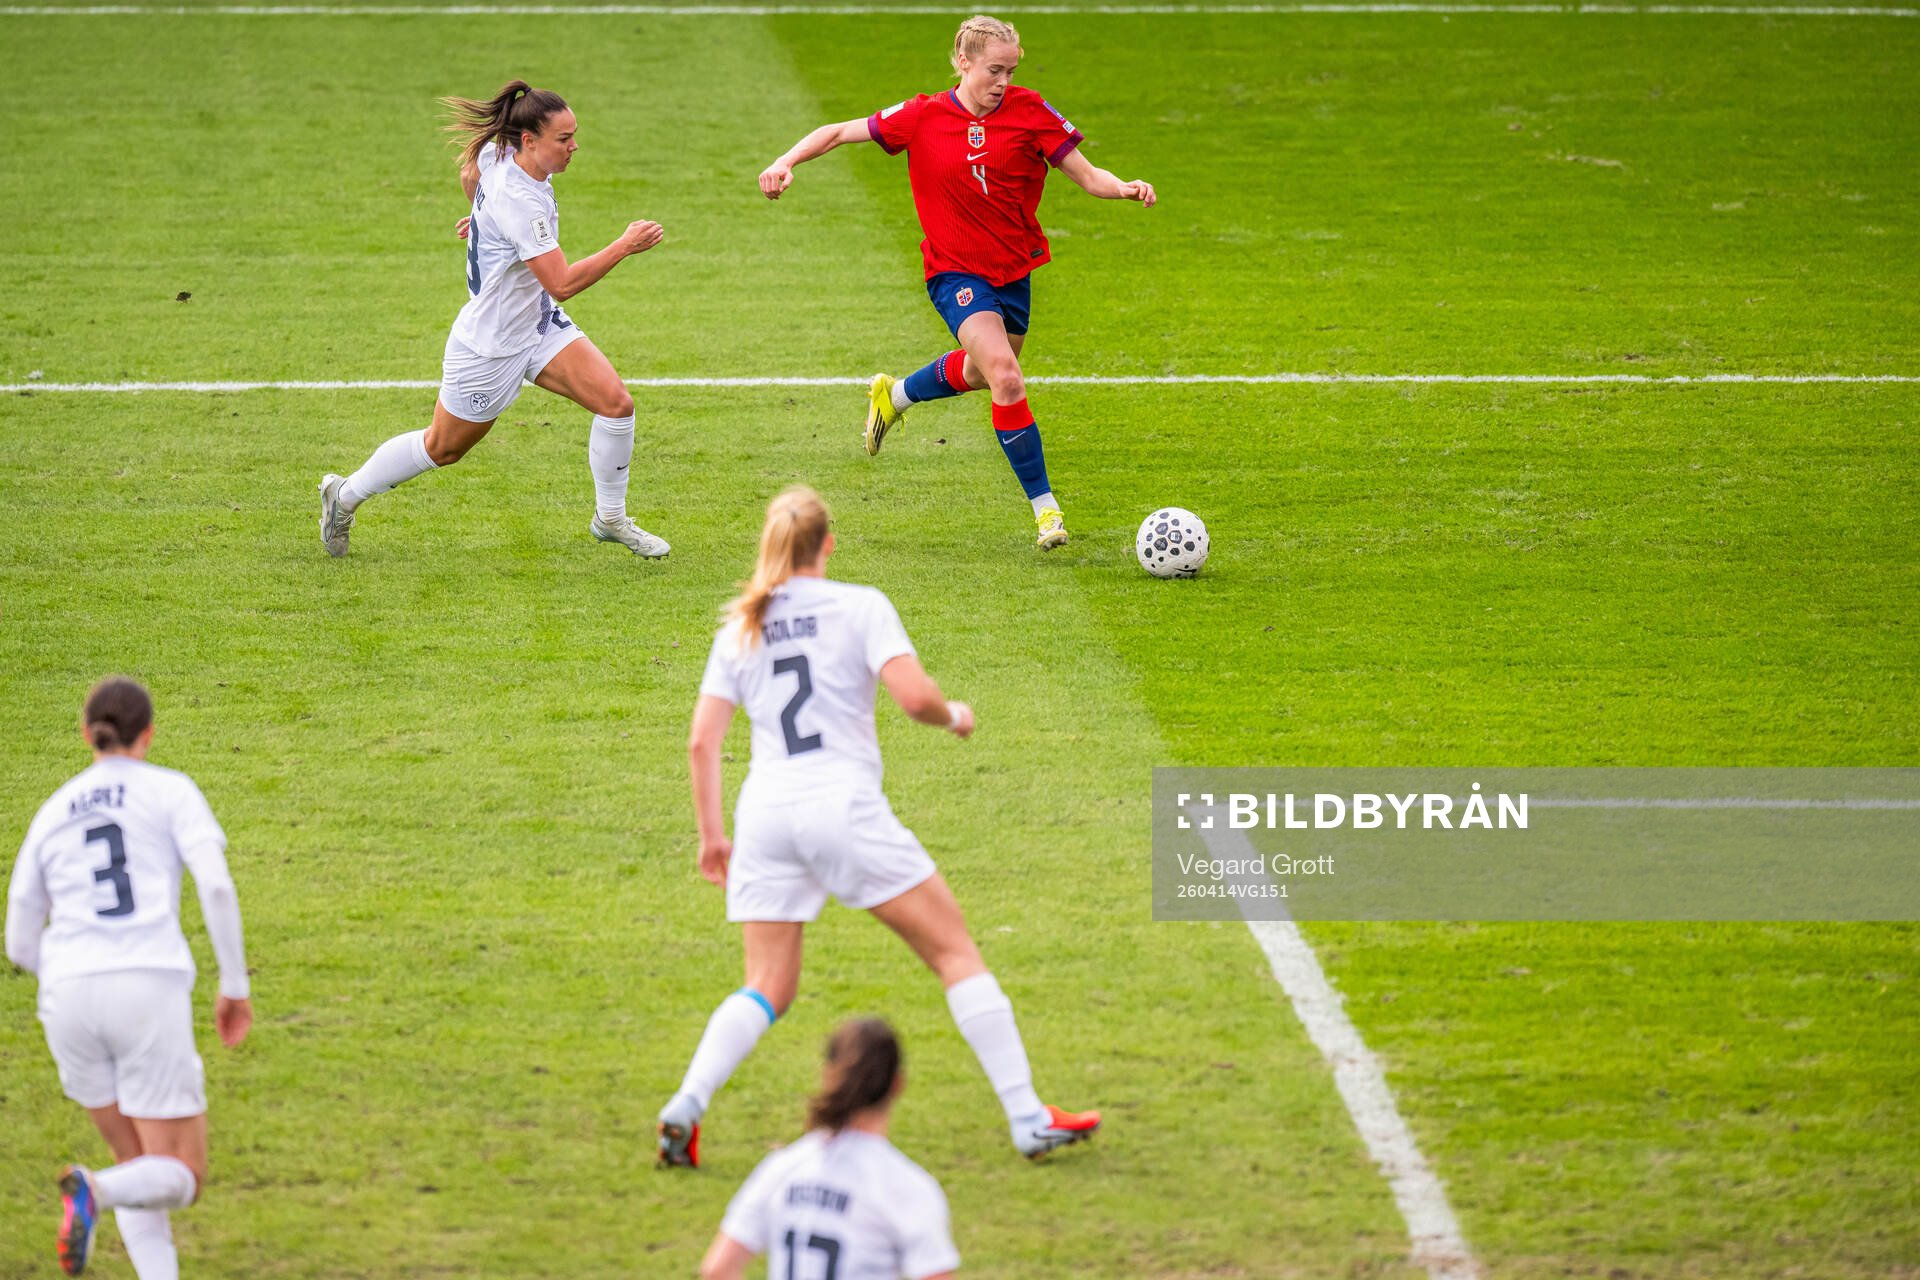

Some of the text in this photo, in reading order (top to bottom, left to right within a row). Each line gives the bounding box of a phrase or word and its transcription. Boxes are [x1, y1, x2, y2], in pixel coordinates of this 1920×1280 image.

[971, 164, 989, 196] 4
[773, 654, 822, 756] 2
[86, 823, 135, 917] 3
